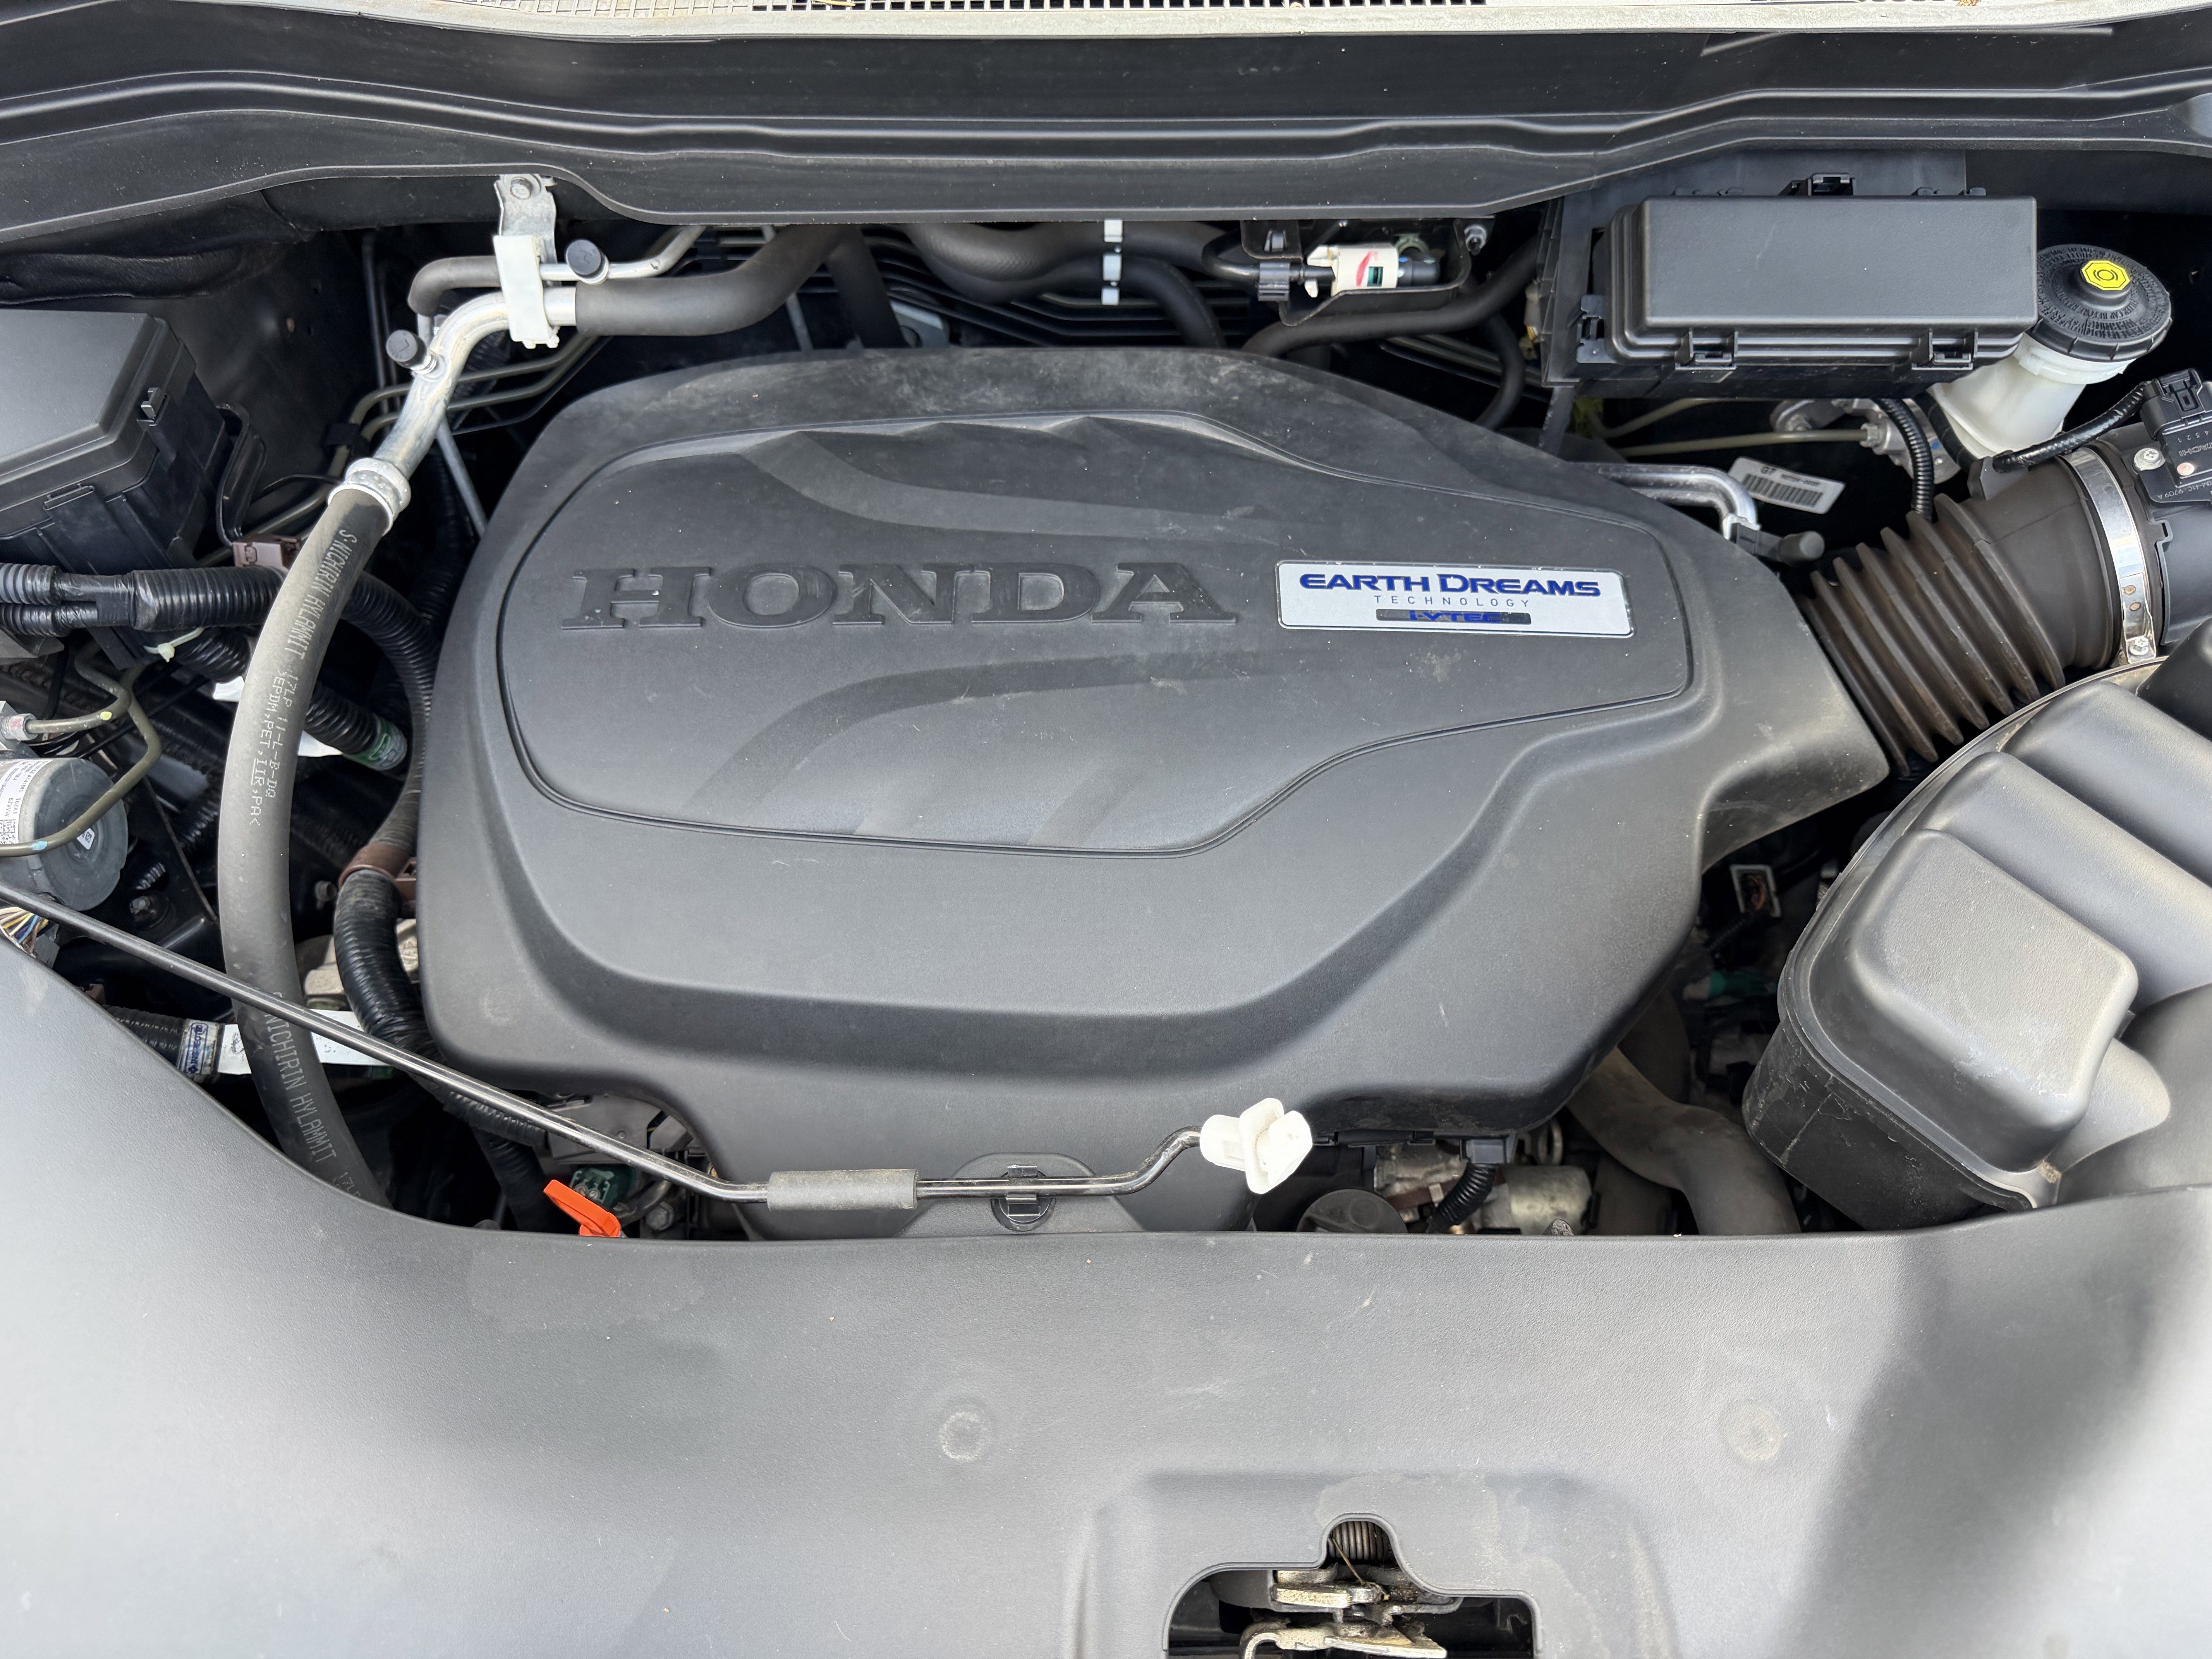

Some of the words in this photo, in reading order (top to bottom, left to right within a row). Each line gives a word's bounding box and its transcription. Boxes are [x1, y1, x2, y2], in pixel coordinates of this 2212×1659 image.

[561, 563, 1239, 630] HONDA
[1299, 573, 1431, 592] EARTH
[1436, 574, 1601, 597] DREAMS
[1374, 595, 1529, 608] TECHNOLOGY
[285, 594, 326, 659] HYLAMMIT
[290, 1092, 337, 1163] HYLAMMIT
